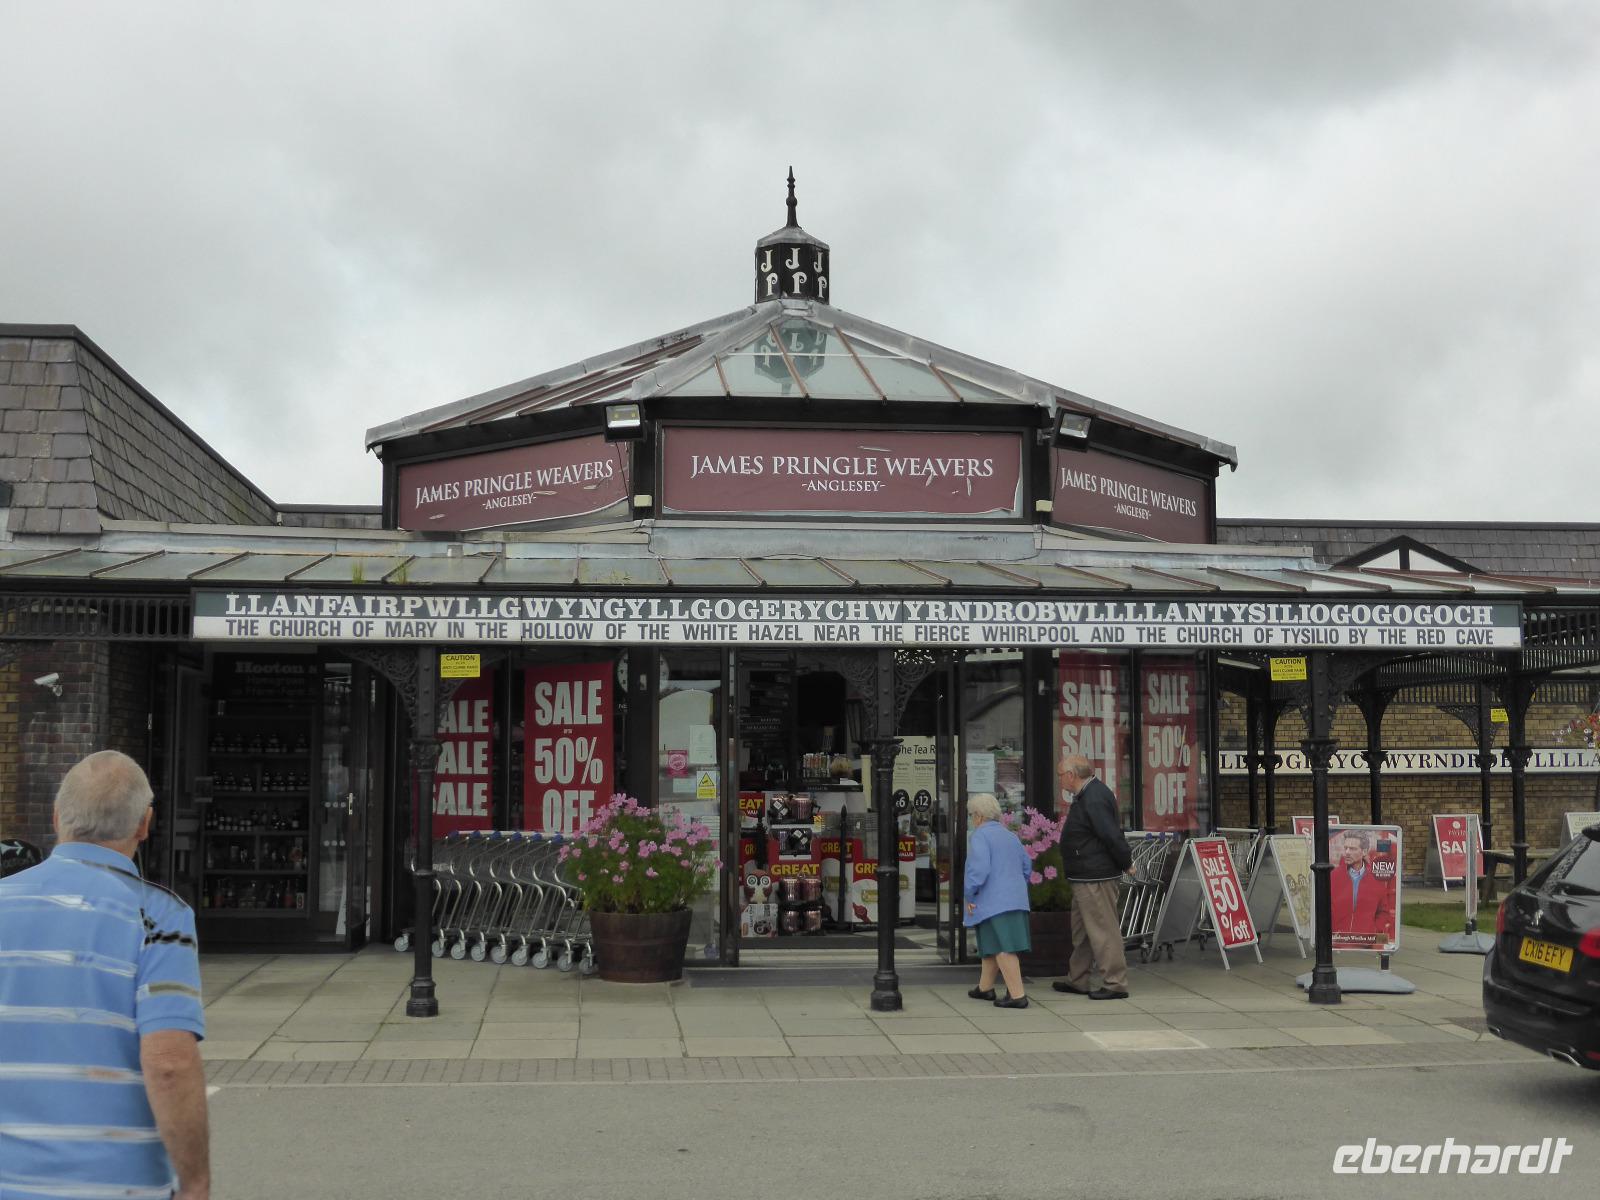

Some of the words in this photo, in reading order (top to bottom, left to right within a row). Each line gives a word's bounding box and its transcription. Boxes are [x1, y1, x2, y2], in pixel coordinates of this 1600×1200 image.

[415, 482, 460, 509] JAMES
[464, 471, 533, 500] PRINGLE
[536, 458, 614, 489] WEAVERS
[691, 455, 764, 479] JAMES
[772, 456, 878, 476] PRINGLE
[883, 457, 994, 478] WEAVERS
[1061, 467, 1097, 493] JAMES
[1100, 477, 1149, 506] PRINGLE
[1150, 489, 1197, 518] WEAVERS
[225, 593, 1493, 625] LLANFAIRPWLLGWYNGYLLGOGERYCHWYRNDROBWLLLLANTYSILIOGOGOGOCH
[226, 619, 259, 637] THE
[270, 619, 341, 638] CHURCH
[353, 620, 374, 638] OF
[386, 620, 437, 639] MARY
[448, 621, 464, 639] IN
[476, 621, 508, 639] THE
[521, 621, 593, 640] HOLLOW
[605, 622, 627, 640] OF
[638, 622, 670, 640] THE
[682, 623, 738, 641] WHITE
[750, 623, 803, 641] HAZEL
[814, 624, 860, 642] NEAR
[872, 624, 902, 642] THE
[914, 624, 970, 643] FIERCE
[982, 625, 1079, 644] WHIRLPOOL
[1091, 626, 1125, 644] AND
[1136, 626, 1166, 644] THE
[1176, 626, 1243, 645] CHURCH
[1254, 627, 1274, 645] OF
[1281, 627, 1339, 646] TYSILIO
[1350, 628, 1367, 646] BY
[1379, 628, 1407, 646] THE
[1416, 628, 1446, 646] RED
[1456, 628, 1494, 646] CAVE
[534, 680, 602, 726] SALE
[1062, 681, 1115, 718] SALE
[1149, 673, 1189, 715] SALE
[437, 700, 489, 734] ALE
[434, 740, 489, 775] ALE
[914, 744, 928, 755] Tea
[1062, 723, 1116, 761] SALE
[1149, 725, 1191, 768] 50%
[534, 737, 603, 784] 50%
[432, 781, 488, 817] ALE
[543, 789, 596, 833] OFF
[739, 799, 764, 810] EAT
[1154, 773, 1187, 816] OFF
[771, 863, 820, 876] GREAT
[1202, 857, 1229, 877] SALE
[1372, 861, 1395, 871] NEW
[1210, 877, 1239, 913] 50
[1525, 939, 1544, 960] CX16
[1545, 943, 1566, 965] EFY
